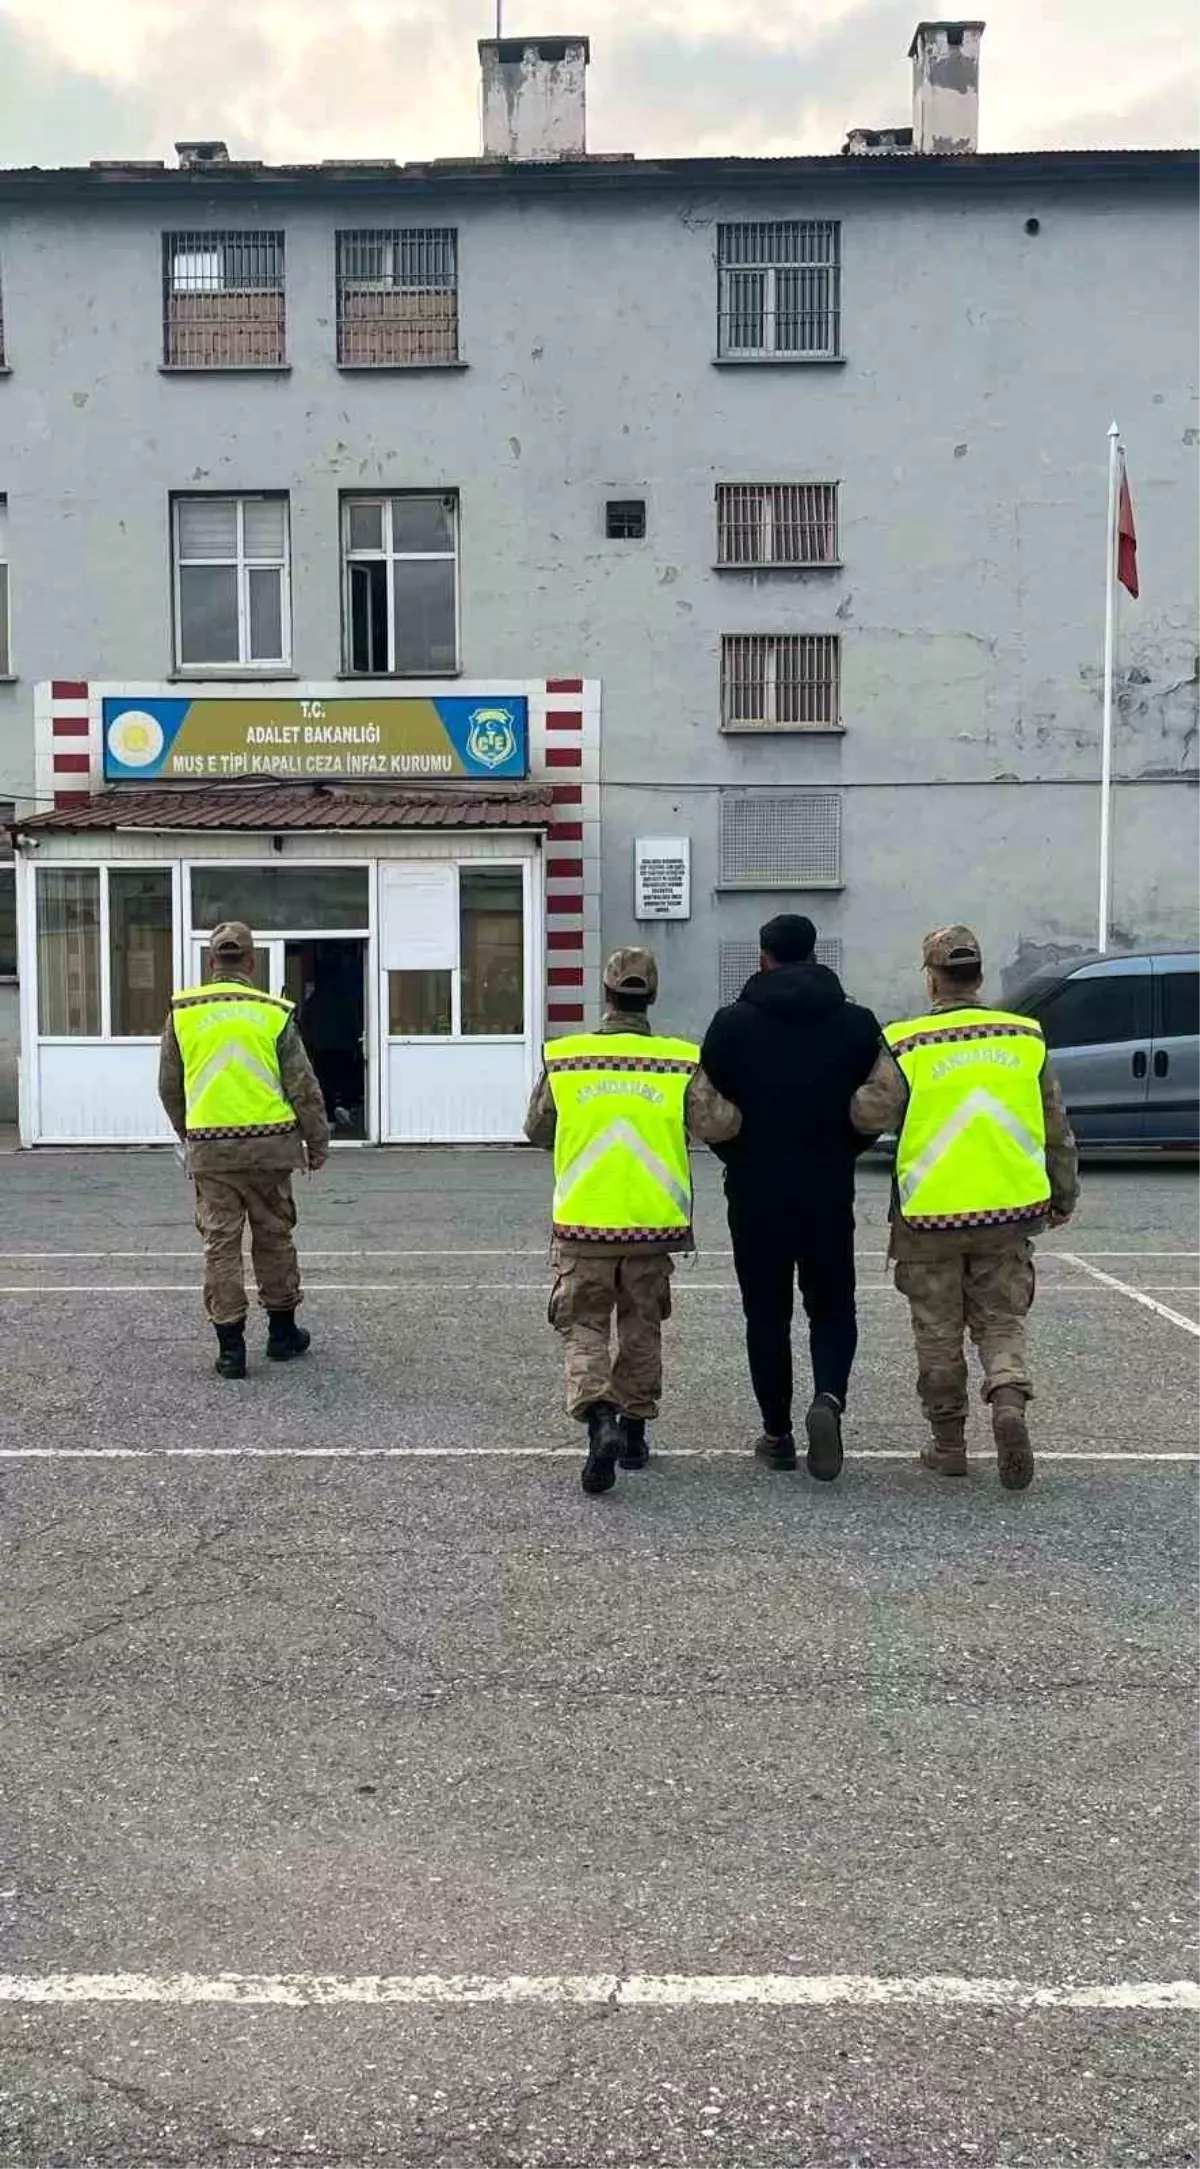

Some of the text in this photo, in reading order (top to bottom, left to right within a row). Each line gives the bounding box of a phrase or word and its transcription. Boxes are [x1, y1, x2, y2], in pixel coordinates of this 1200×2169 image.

[301, 701, 326, 718] T.C.
[246, 721, 380, 744] ADALET BAKANLIĞI
[172, 752, 453, 776] MUŞ E TİPİ KAPALI CEZA İNFAZ KURUMU
